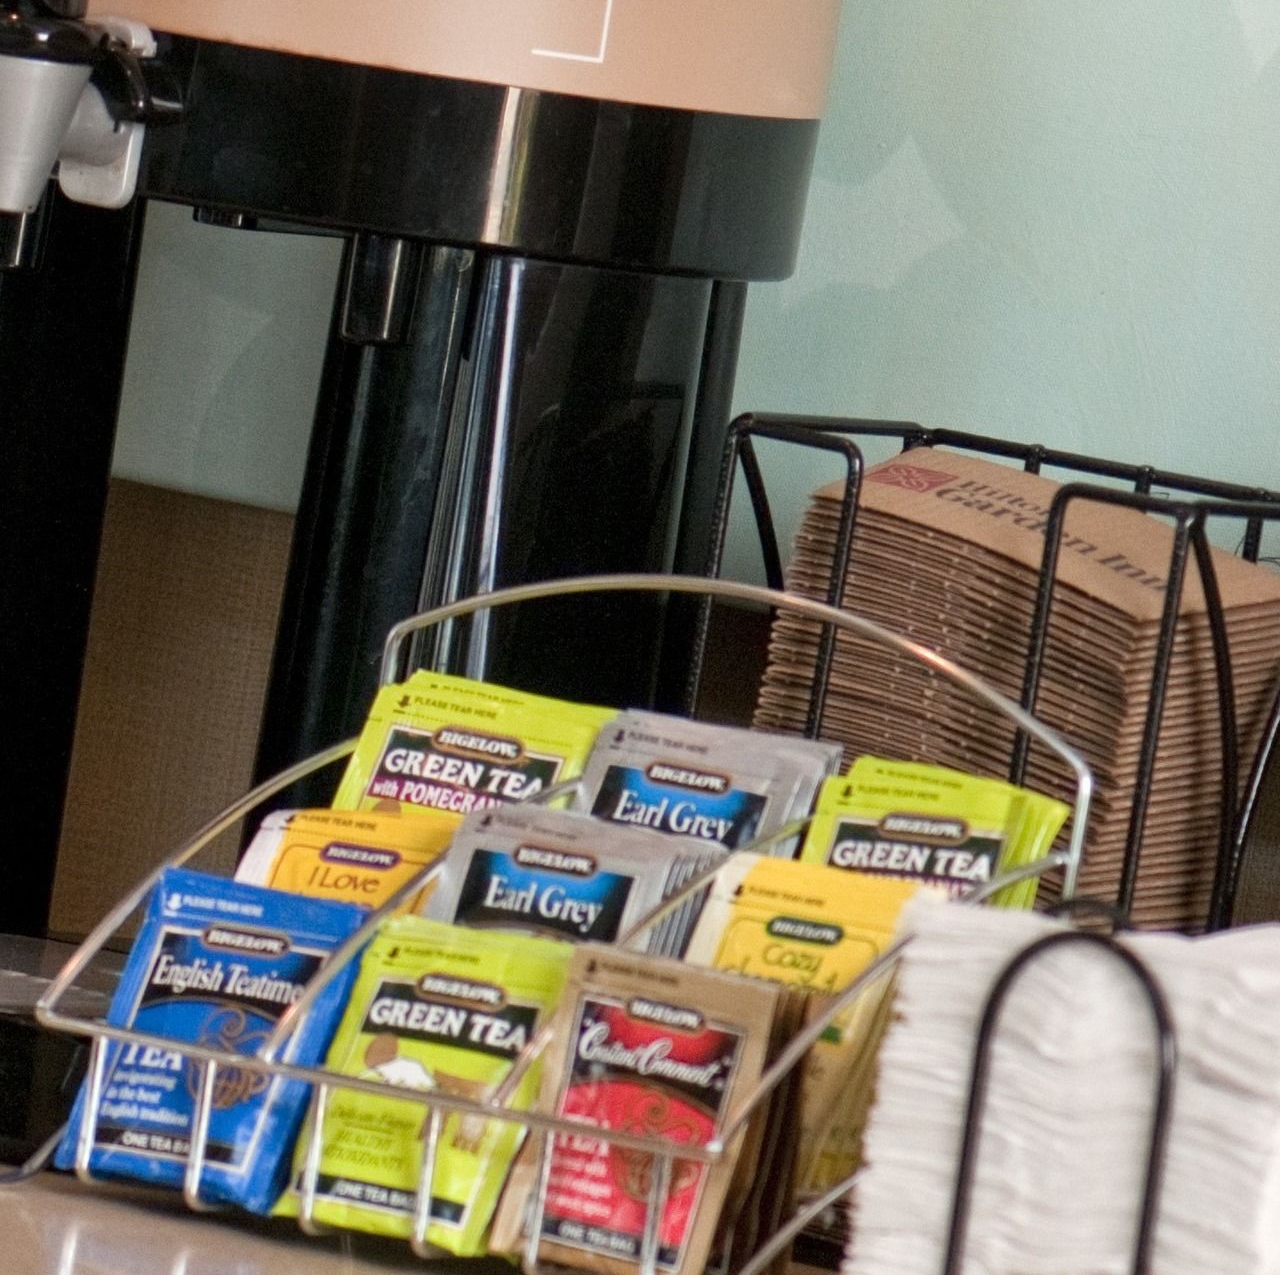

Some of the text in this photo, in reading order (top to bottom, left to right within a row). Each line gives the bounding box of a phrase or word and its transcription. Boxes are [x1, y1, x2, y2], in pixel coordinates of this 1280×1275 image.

[439, 729, 518, 759] BIGELOW
[372, 780, 399, 798] with
[384, 748, 543, 801] GREEN TEA
[650, 764, 725, 791] BIGELOW
[612, 789, 669, 828] Earl
[669, 801, 735, 842] Grey
[308, 866, 380, 893] I Love
[832, 839, 990, 883] GREEN TEA
[483, 875, 603, 933] Earl Grey
[152, 954, 225, 993] English
[369, 997, 527, 1052] GREEN TEA
[122, 1131, 148, 1148] ONE
[150, 1134, 172, 1150] TEA
